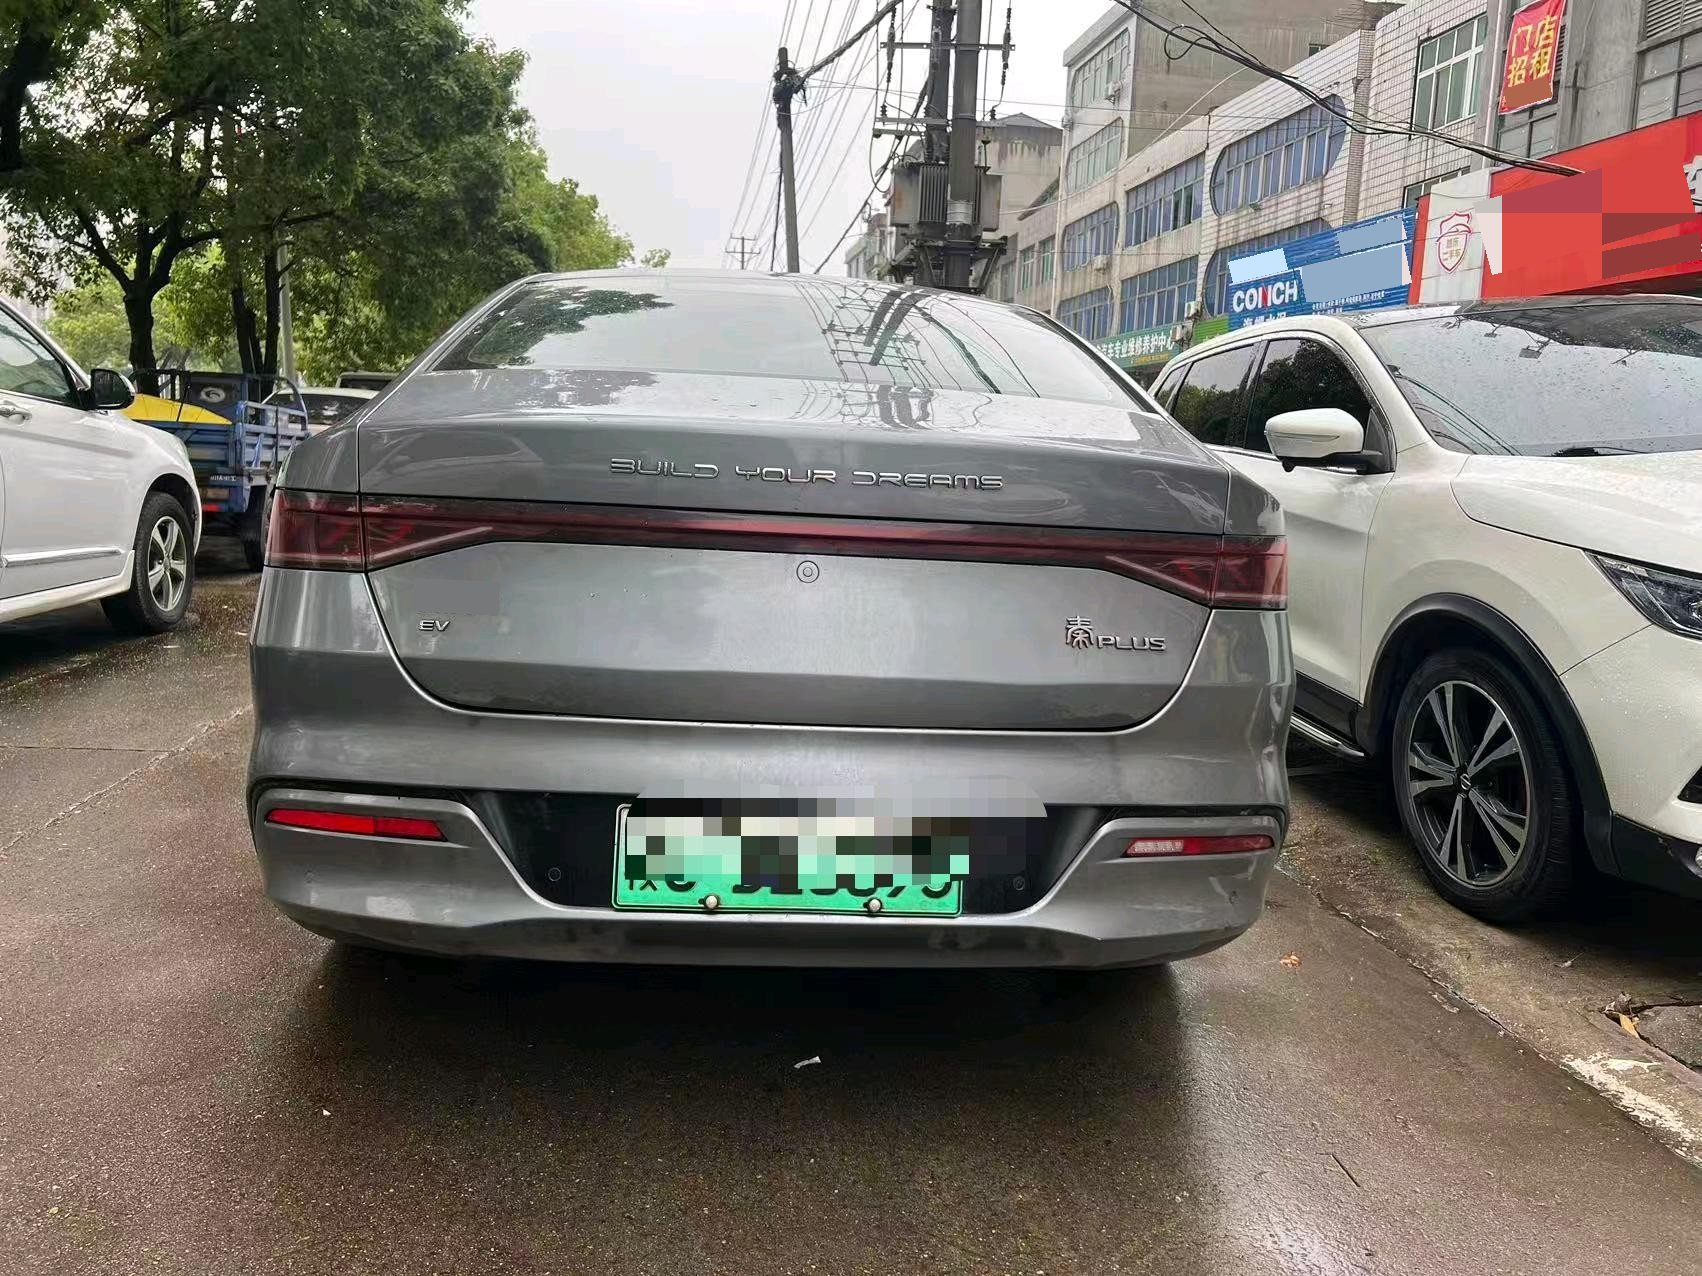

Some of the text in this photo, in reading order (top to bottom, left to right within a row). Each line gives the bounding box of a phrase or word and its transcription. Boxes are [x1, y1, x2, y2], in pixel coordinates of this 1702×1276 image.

[1512, 15, 1557, 57] 门店
[1508, 48, 1552, 88] 招租
[1232, 280, 1299, 313] CONCH
[1096, 329, 1175, 359] 汽车专业维修养护中心
[610, 458, 1003, 490] BUILD YOUR DREAMS
[419, 619, 451, 632] EV
[1097, 634, 1168, 652] PLUS
